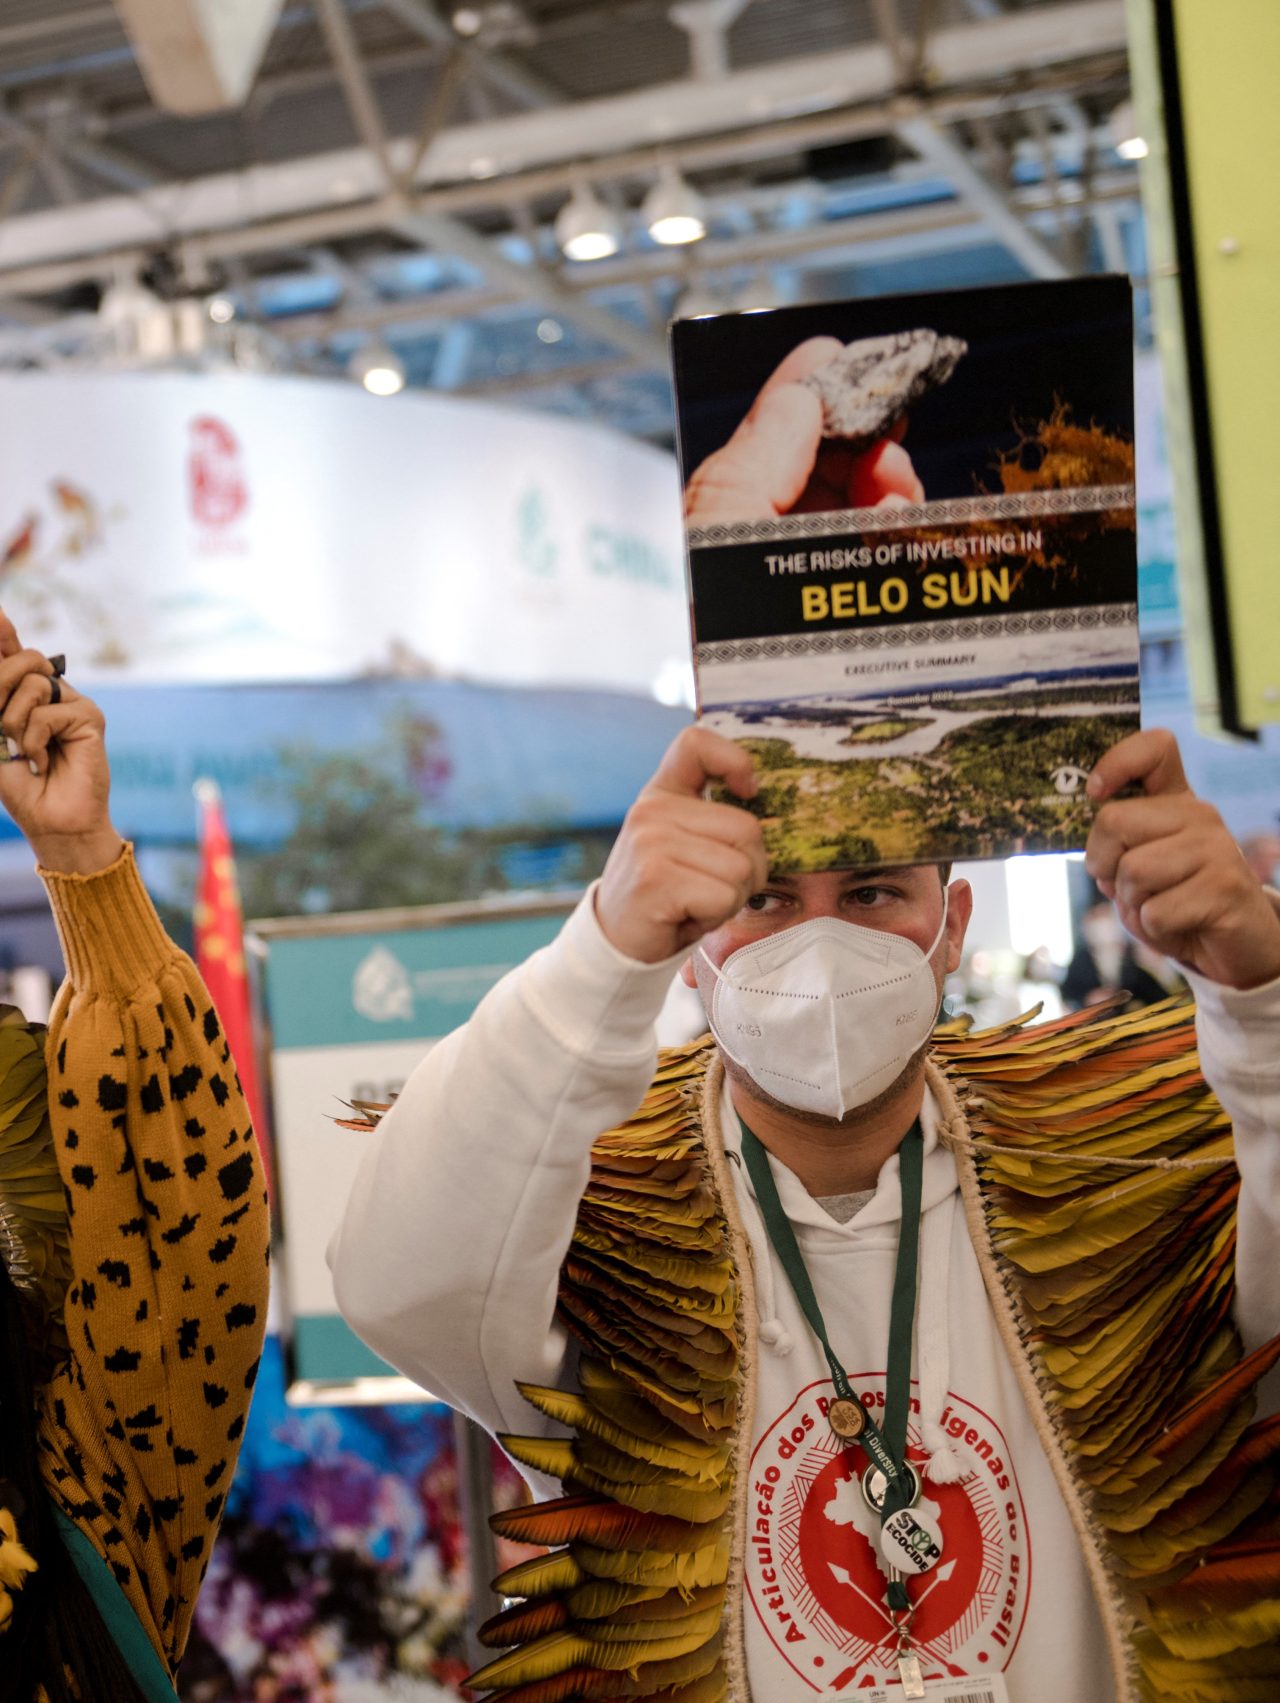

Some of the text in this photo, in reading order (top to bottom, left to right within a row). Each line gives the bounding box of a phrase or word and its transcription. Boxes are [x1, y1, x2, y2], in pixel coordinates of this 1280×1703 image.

[764, 530, 1042, 576] THE RISKS OF INVESTING IN
[801, 568, 1011, 622] BELO SUN
[844, 652, 976, 676] EXECUTIVE SUMMARY
[777, 1412, 816, 1460] dos
[869, 1436, 899, 1479] Diversity
[751, 1465, 807, 1644] Articulação
[885, 1522, 930, 1573] ECOCIDE
[896, 1511, 941, 1561] STOP
[990, 1555, 1020, 1649] Brasil
